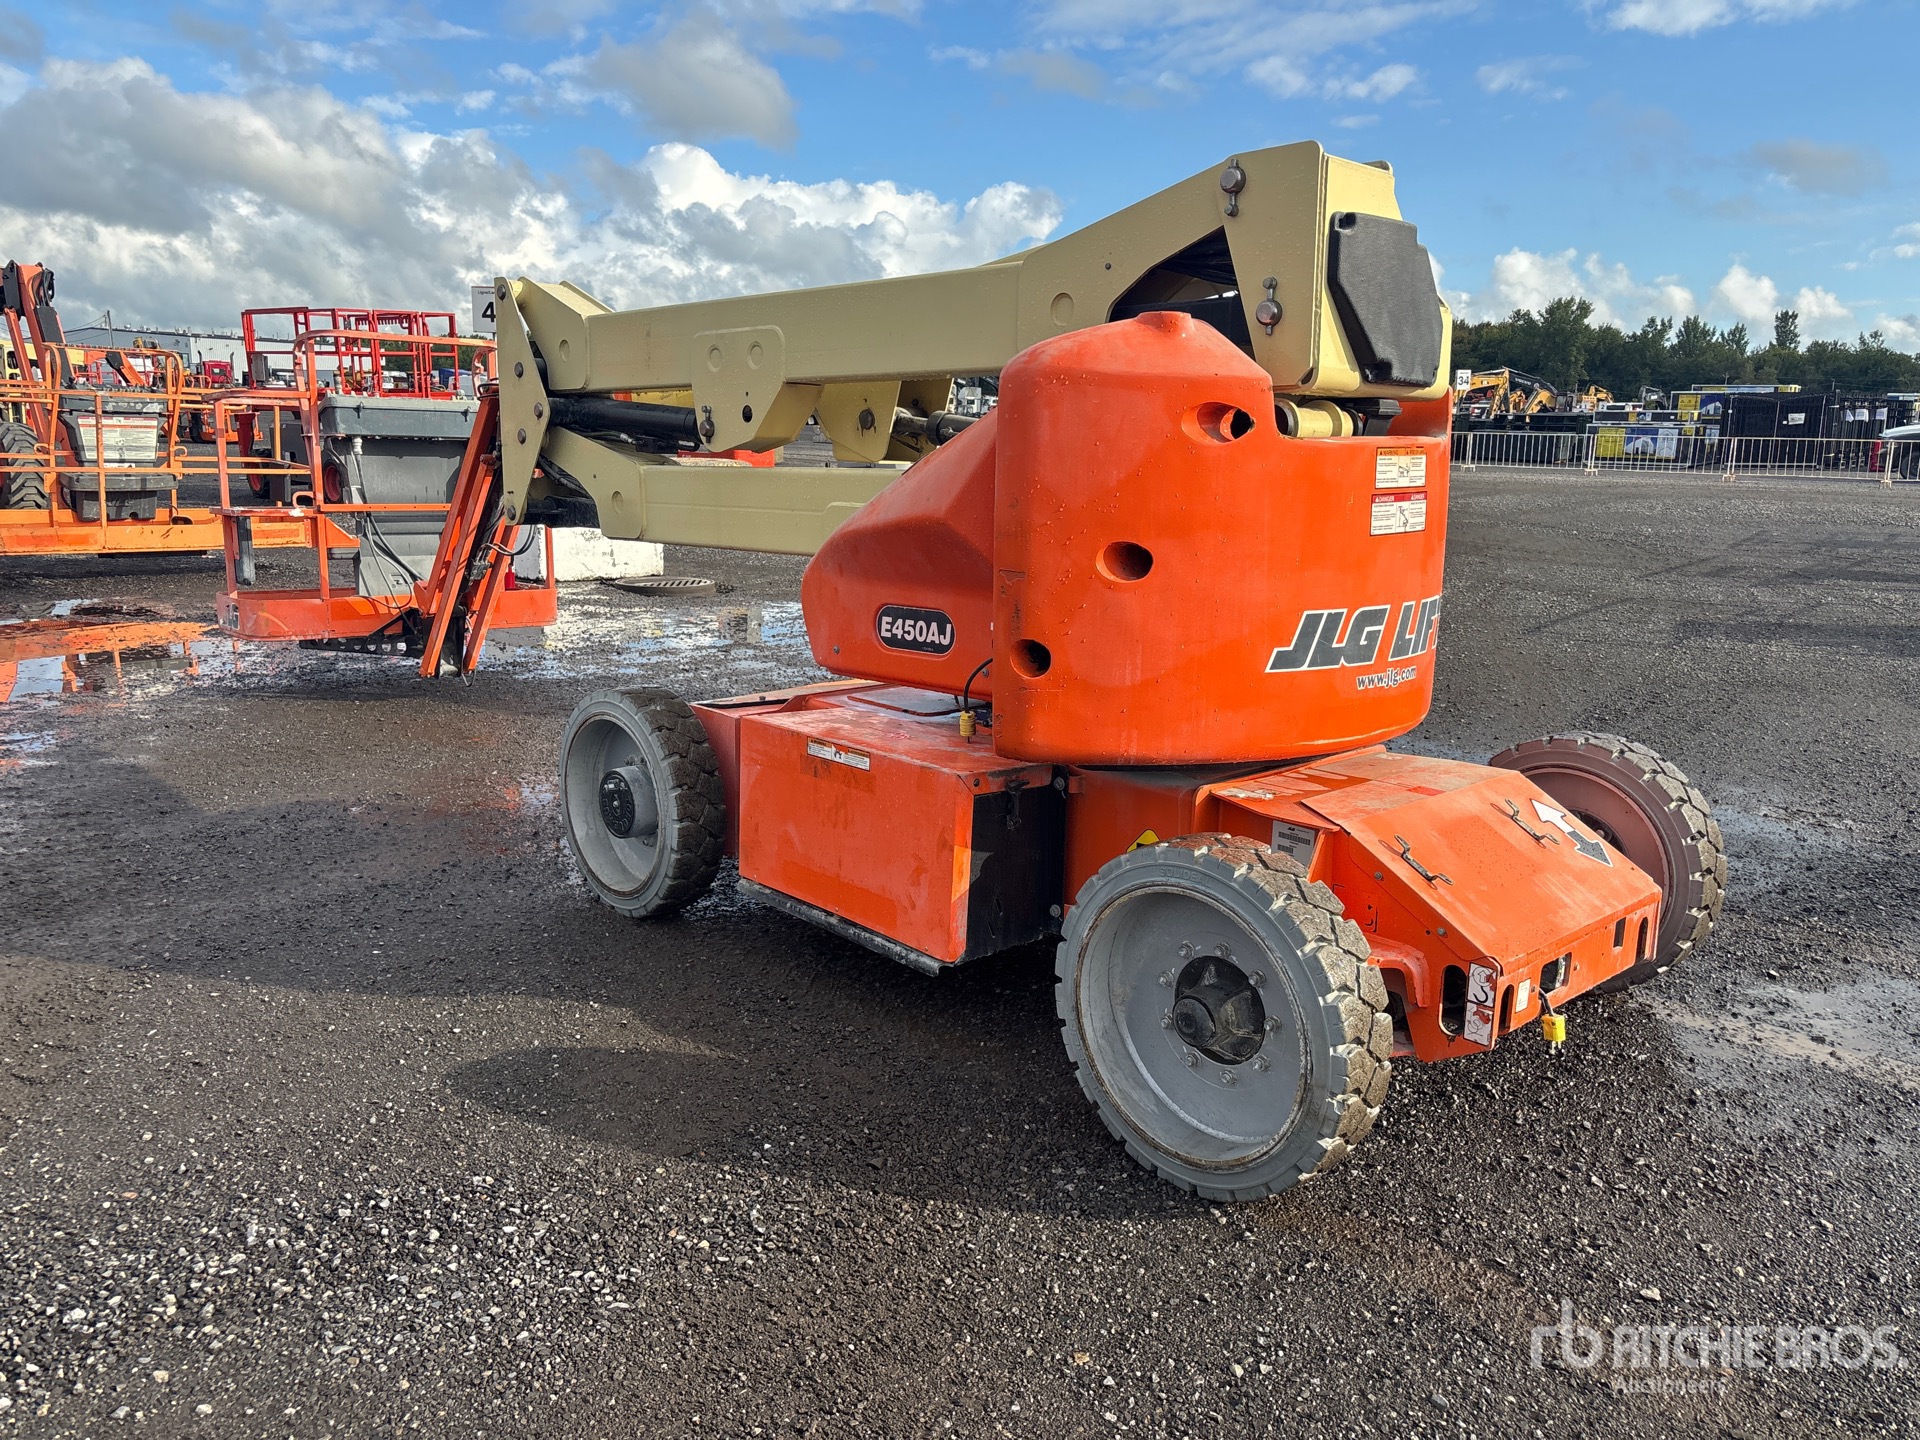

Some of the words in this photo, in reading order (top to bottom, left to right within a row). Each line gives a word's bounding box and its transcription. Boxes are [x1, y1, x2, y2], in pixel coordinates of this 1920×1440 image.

[482, 301, 496, 323] 4
[1458, 375, 1469, 386] 34
[881, 616, 952, 646] E450AJ
[1265, 604, 1391, 673] JLG
[1356, 666, 1417, 691] www.jlg.com
